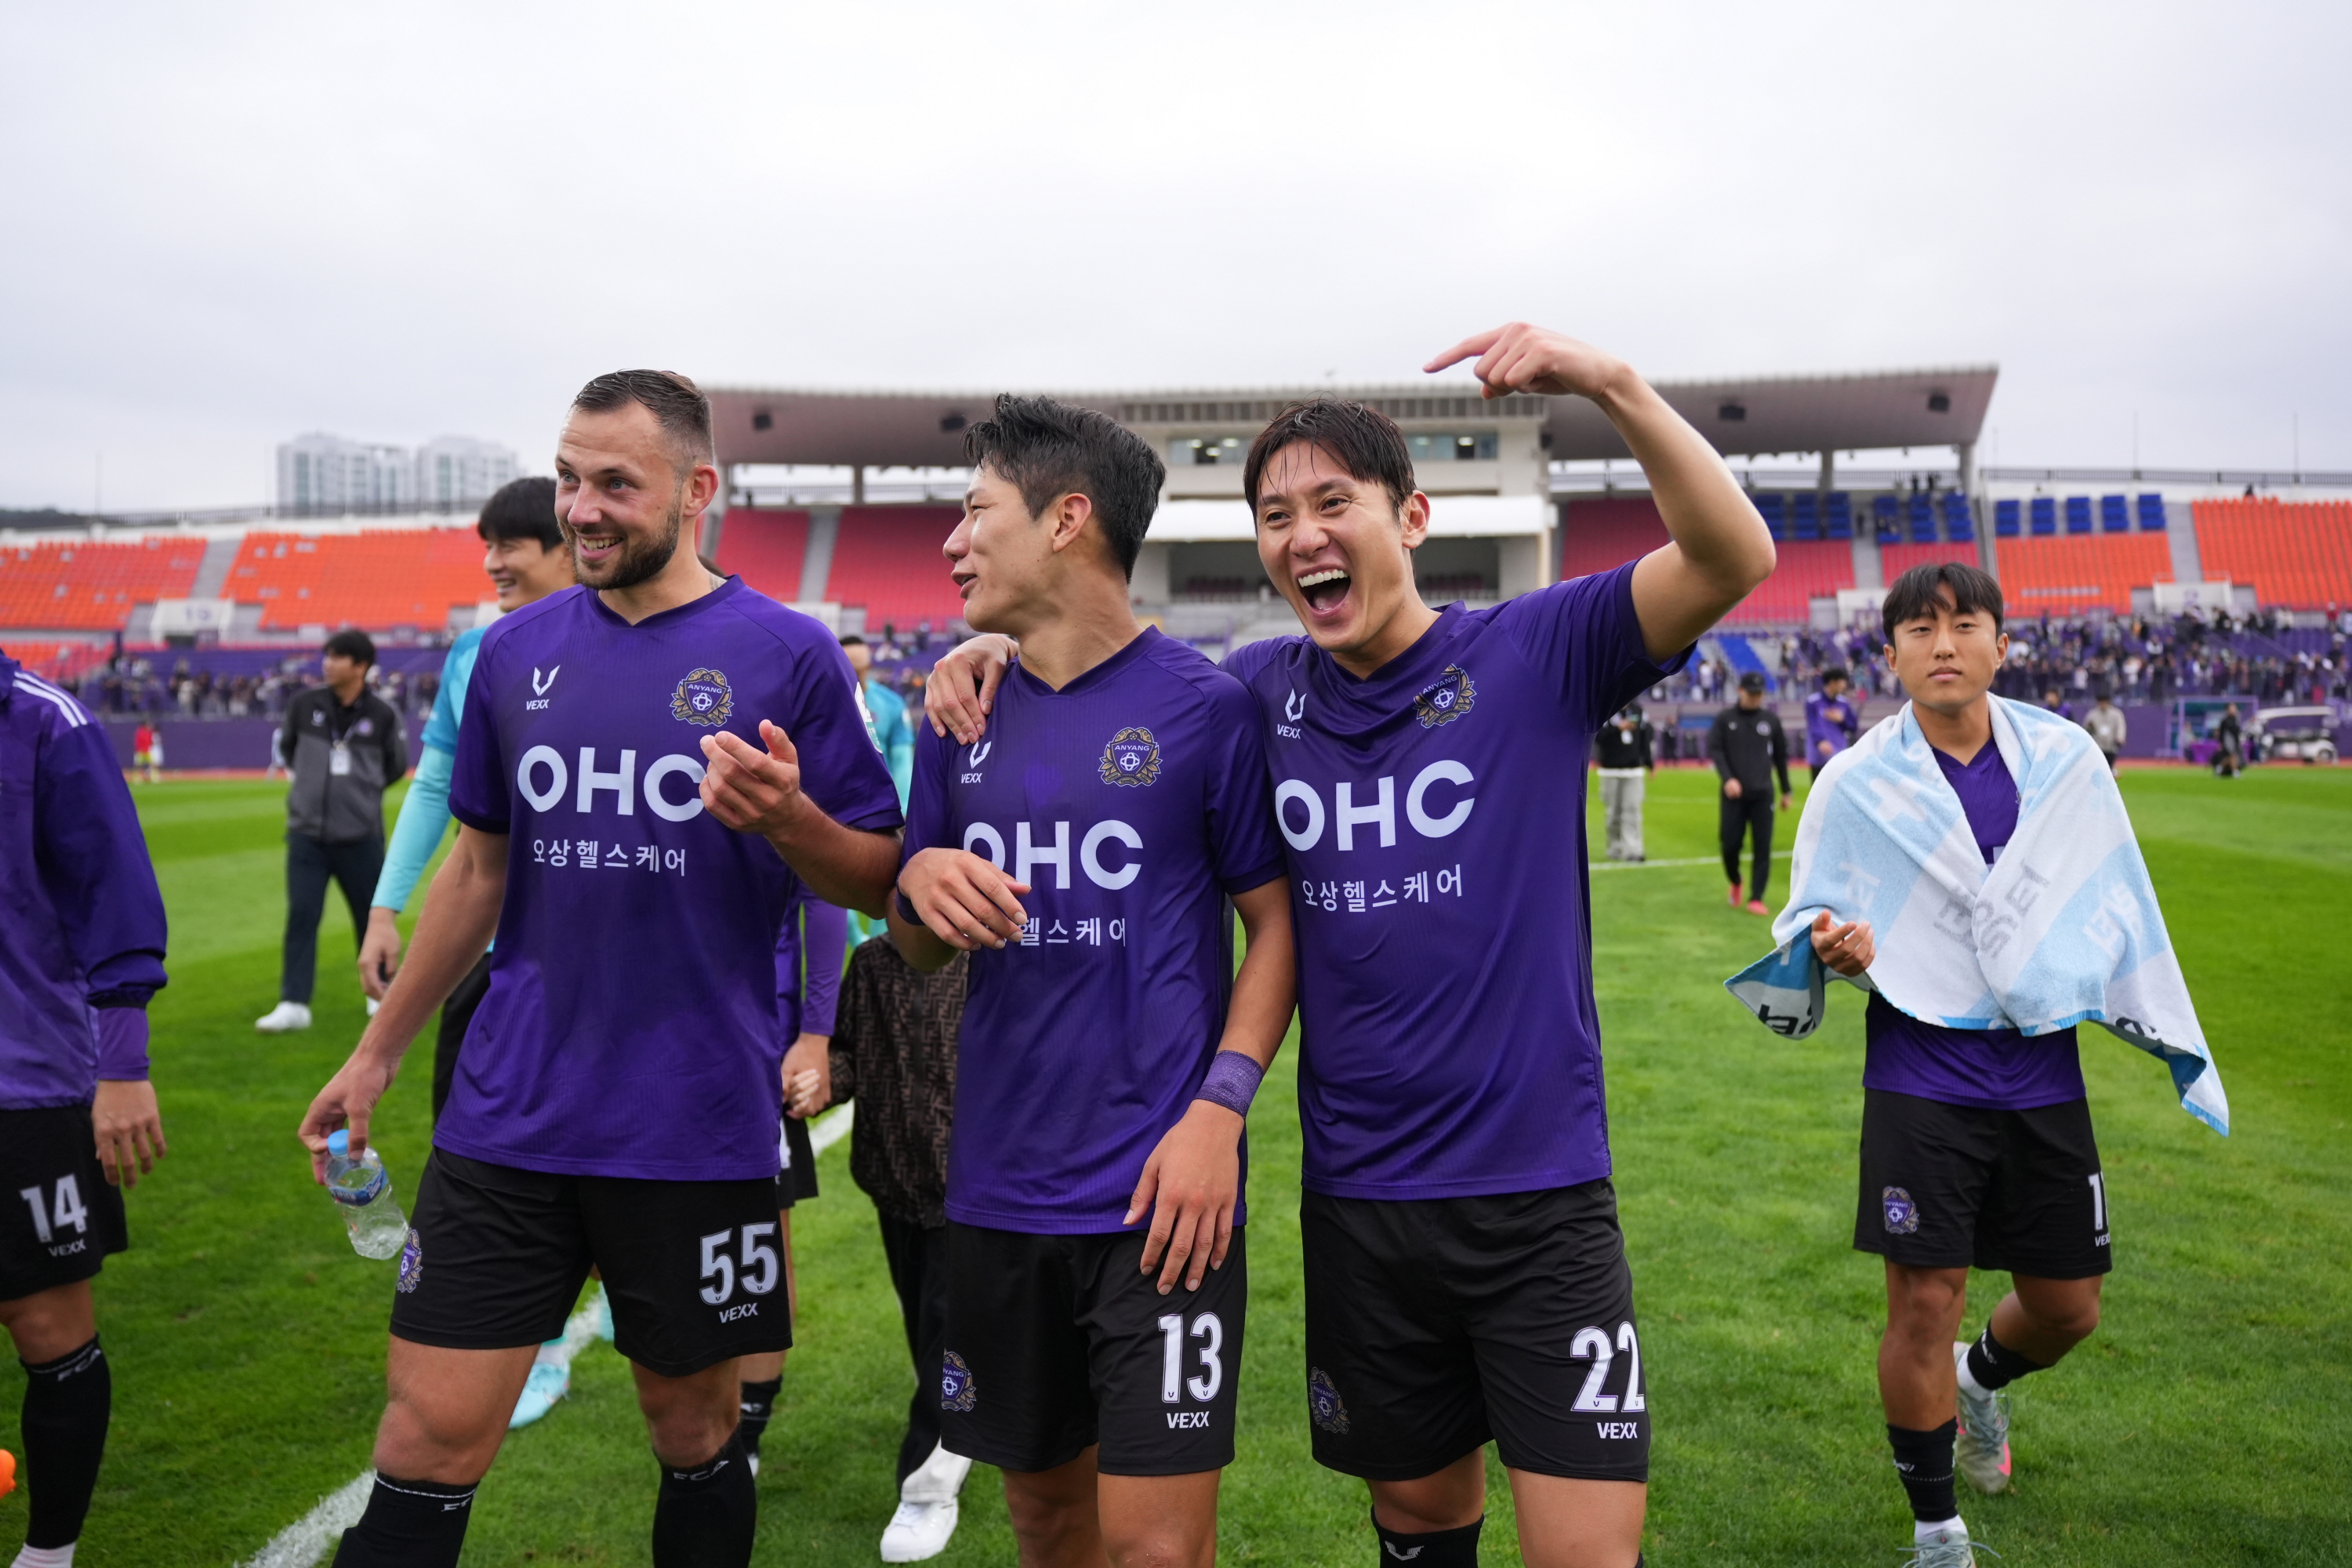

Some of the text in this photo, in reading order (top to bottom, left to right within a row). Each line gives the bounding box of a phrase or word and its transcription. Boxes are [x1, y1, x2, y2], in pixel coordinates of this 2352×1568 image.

[688, 684, 723, 694] ANYANG
[1423, 675, 1457, 695] ANYANG
[526, 699, 550, 710] VEXX
[1276, 724, 1301, 739] VEXX
[517, 745, 707, 822] OHC
[960, 773, 983, 784] VEXX
[1276, 760, 1475, 852] OHC
[533, 839, 686, 877] 오상헬스케어
[1302, 863, 1463, 913] 오상헬스케어
[1018, 917, 1127, 947] 헬스케어
[19, 1173, 89, 1243] 14
[48, 1239, 87, 1258] VEXX
[699, 1221, 779, 1305] 55
[719, 1302, 759, 1323] VEXX
[1157, 1312, 1223, 1403] 13
[1570, 1320, 1645, 1413] 22
[1313, 1385, 1334, 1399] ANYANG
[1167, 1410, 1210, 1429] VEXX
[1597, 1422, 1638, 1439] VEXX
